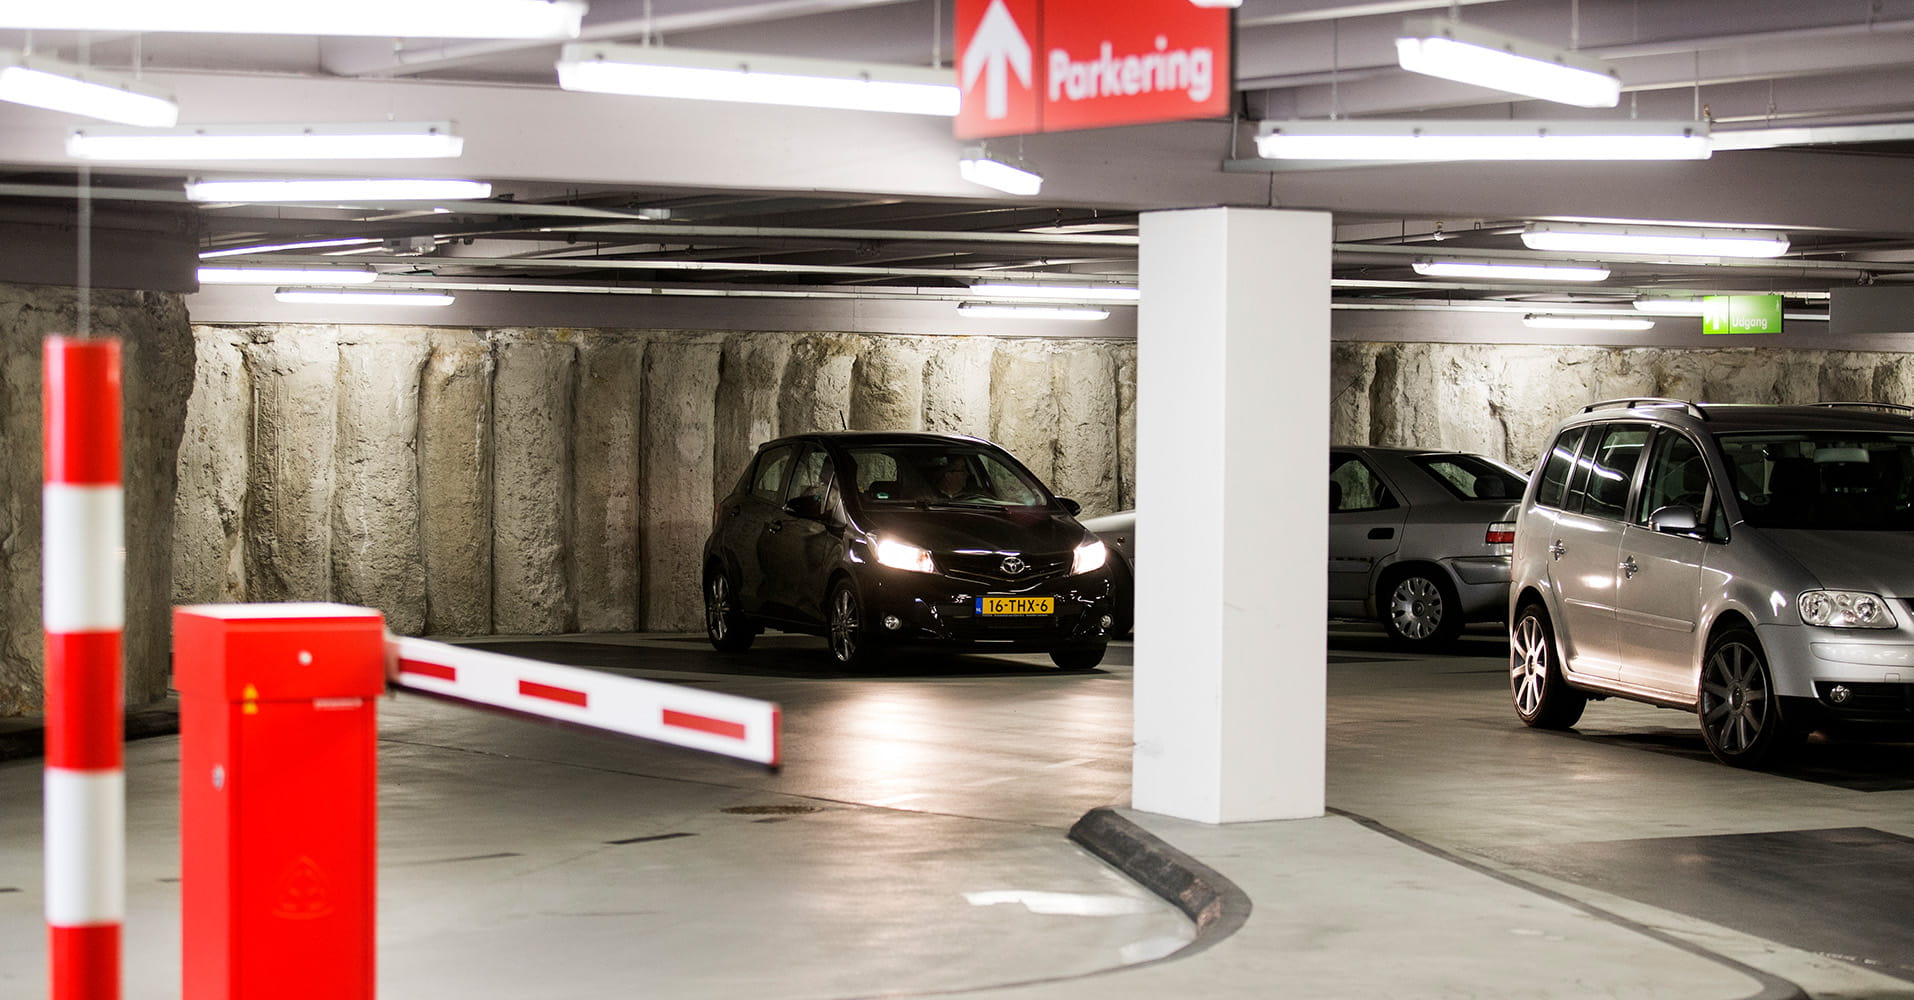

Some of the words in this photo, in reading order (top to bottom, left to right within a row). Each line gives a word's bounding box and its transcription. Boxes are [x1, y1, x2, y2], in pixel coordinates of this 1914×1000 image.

[1049, 34, 1213, 102] Parkering
[1732, 313, 1768, 330] Udgang
[989, 599, 1049, 613] 16-THX-6
